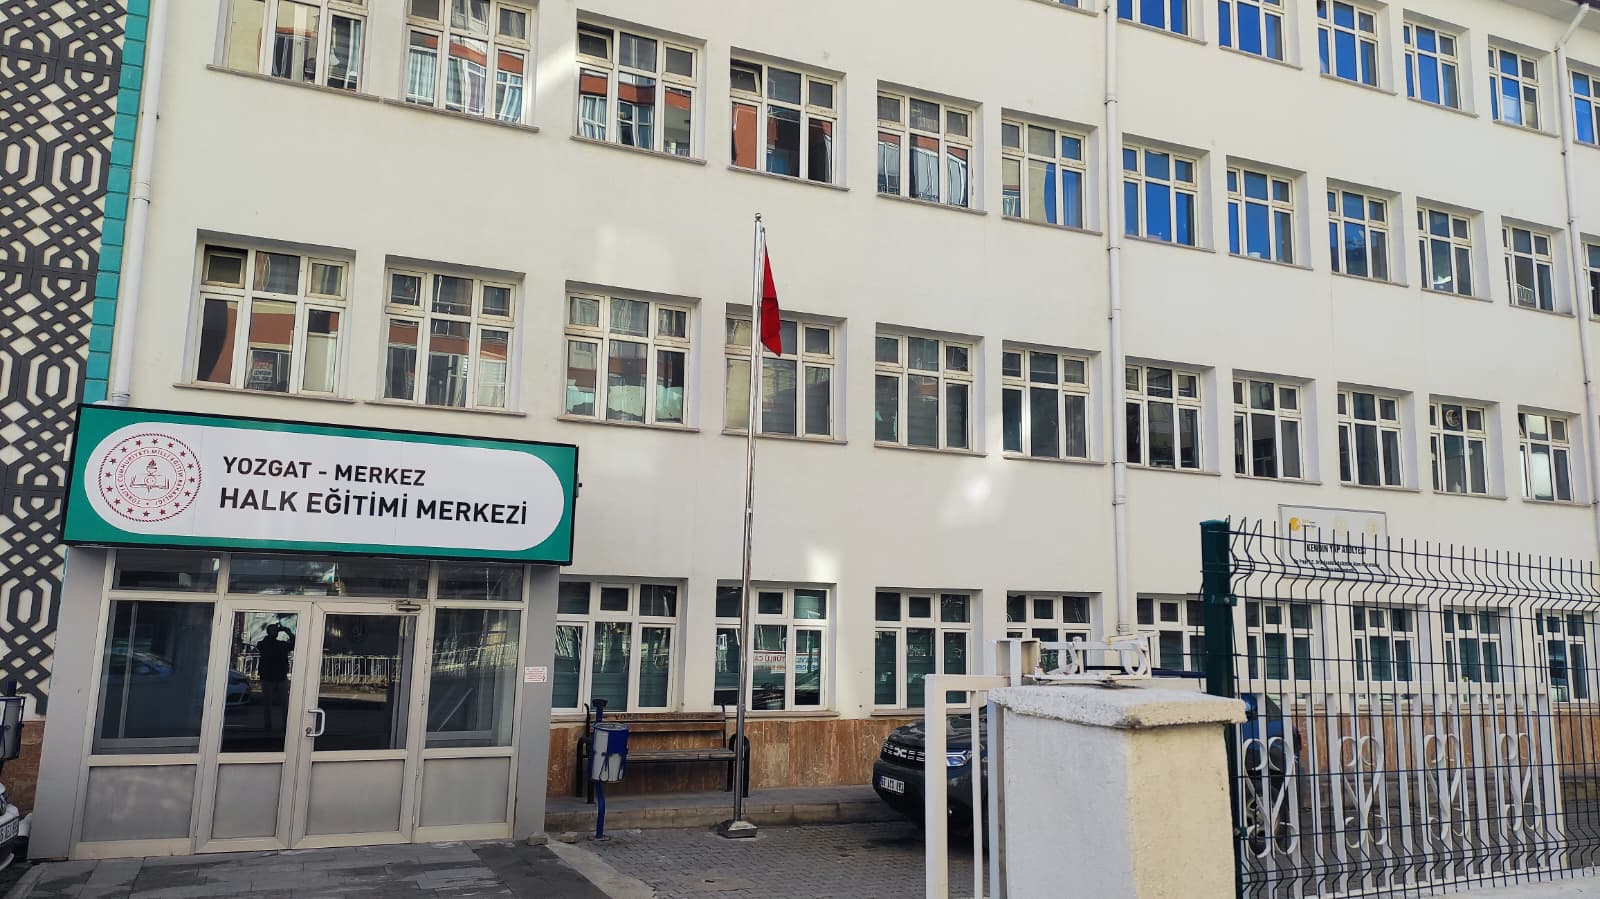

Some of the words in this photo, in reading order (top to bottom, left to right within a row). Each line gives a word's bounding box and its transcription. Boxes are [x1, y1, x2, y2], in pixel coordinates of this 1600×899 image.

[223, 456, 312, 479] YOZGAT
[334, 464, 426, 486] MERKEZ
[219, 487, 299, 512] HALK
[306, 488, 408, 518] EĞİTİMİ
[416, 500, 528, 525] MERKEZİ
